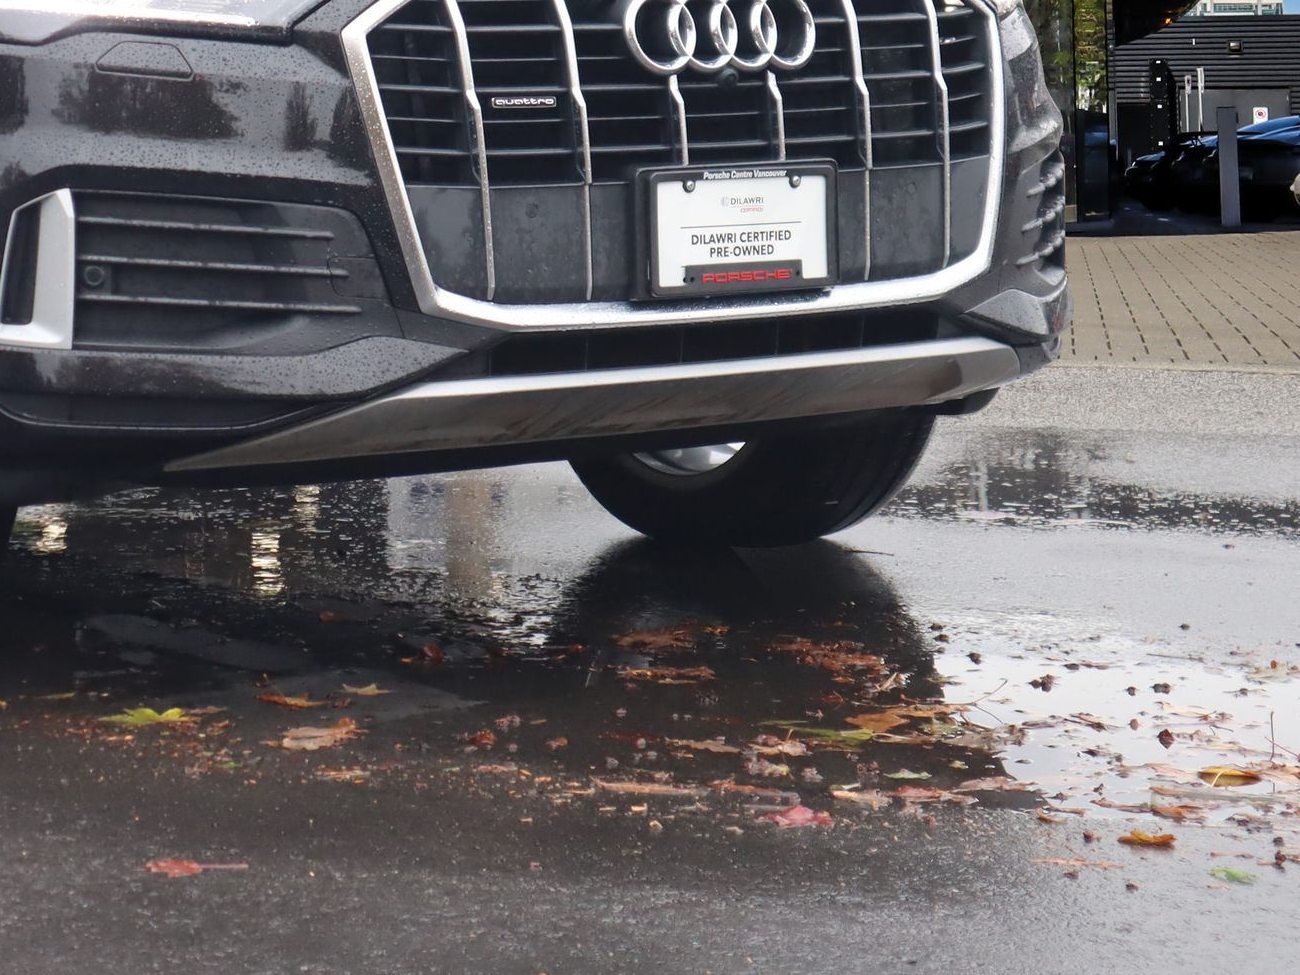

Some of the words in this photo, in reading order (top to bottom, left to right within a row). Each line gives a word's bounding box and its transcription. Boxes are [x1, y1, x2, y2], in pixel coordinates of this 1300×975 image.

[495, 98, 554, 107] quattro
[703, 171, 730, 180] Porsche
[731, 170, 753, 179] Centre
[753, 169, 787, 178] Vancouver
[730, 196, 764, 205] DILAWRI
[691, 232, 737, 245] DILAWRI
[739, 230, 792, 243] CERTIFIED
[709, 244, 774, 258] PRE-OWNED
[702, 268, 791, 283] PORSCHE
